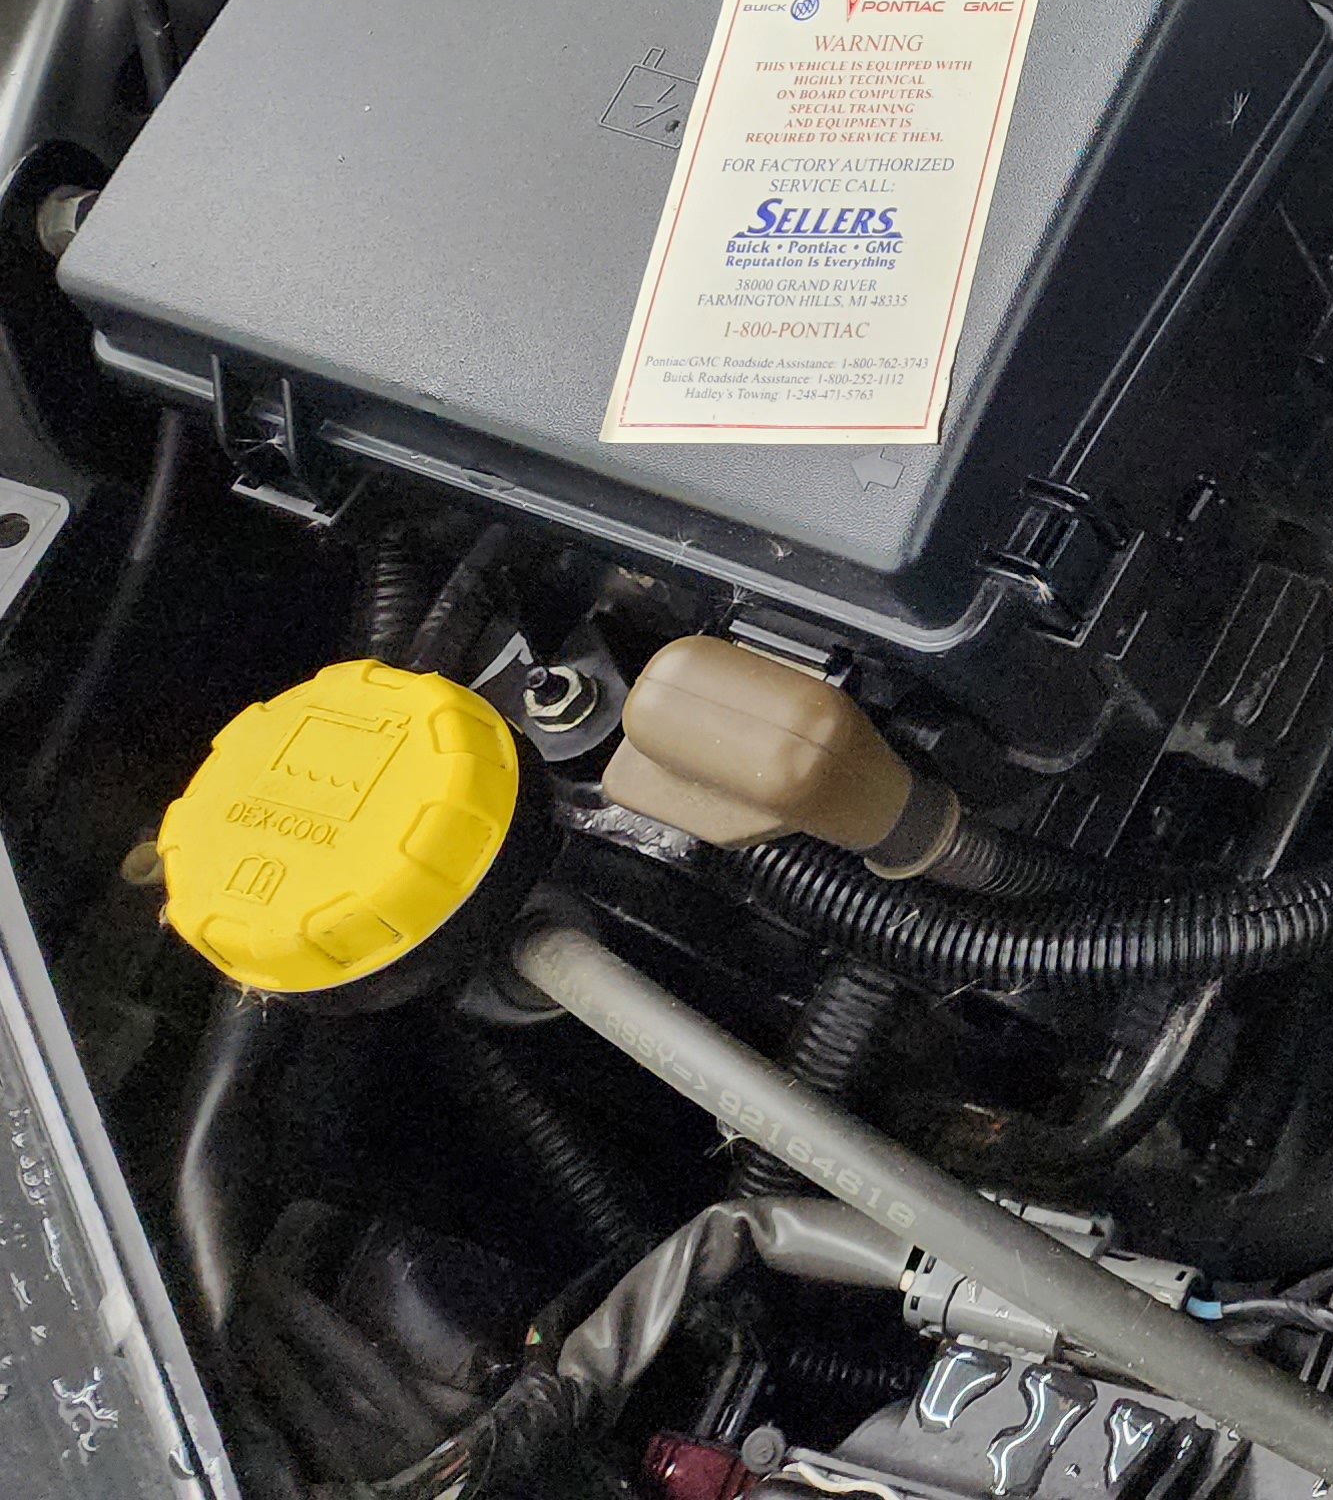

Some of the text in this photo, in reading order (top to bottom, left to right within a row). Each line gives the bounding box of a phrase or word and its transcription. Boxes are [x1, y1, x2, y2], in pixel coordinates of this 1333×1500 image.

[742, 3, 788, 13] BUICK
[860, 0, 947, 13] PONTIAC
[962, 1, 1015, 13] GMC
[814, 34, 924, 52] WARNING
[755, 60, 973, 72] THIS VEHICLE IS EQUIPPED WITH
[793, 74, 925, 85] HIGHLY TECHNICAL
[776, 88, 934, 100] ON BOARD COMPUTERS.
[789, 103, 915, 114] SPECIAL TRAINING
[784, 117, 912, 129] AND EQUIPMENT IS
[745, 131, 943, 143] REQUIRED TO SERVICE THEM.
[722, 157, 956, 172] FOR FACTORY AUTHORIZED
[768, 179, 896, 193] SERVICE CALL:
[746, 197, 898, 235] SELLERS
[725, 240, 904, 254] Buick Pontiac GMC
[725, 256, 896, 270] Reputation Is Everything
[735, 279, 878, 291] 38000 GRAND RIVER
[697, 294, 908, 308] FARMINGTON HILLS, MI 48335
[723, 322, 870, 338] 1-800-PONTIAC
[644, 356, 720, 368] Pontiac/GMC
[723, 357, 775, 369] Roadside
[841, 358, 929, 370] 1-800-762-3743
[662, 372, 695, 384] Buick
[698, 372, 749, 384] Roadside
[817, 373, 905, 385] 1-800-252-1112
[684, 387, 734, 401] Hadley's
[785, 389, 874, 401] 1-248-471-5763
